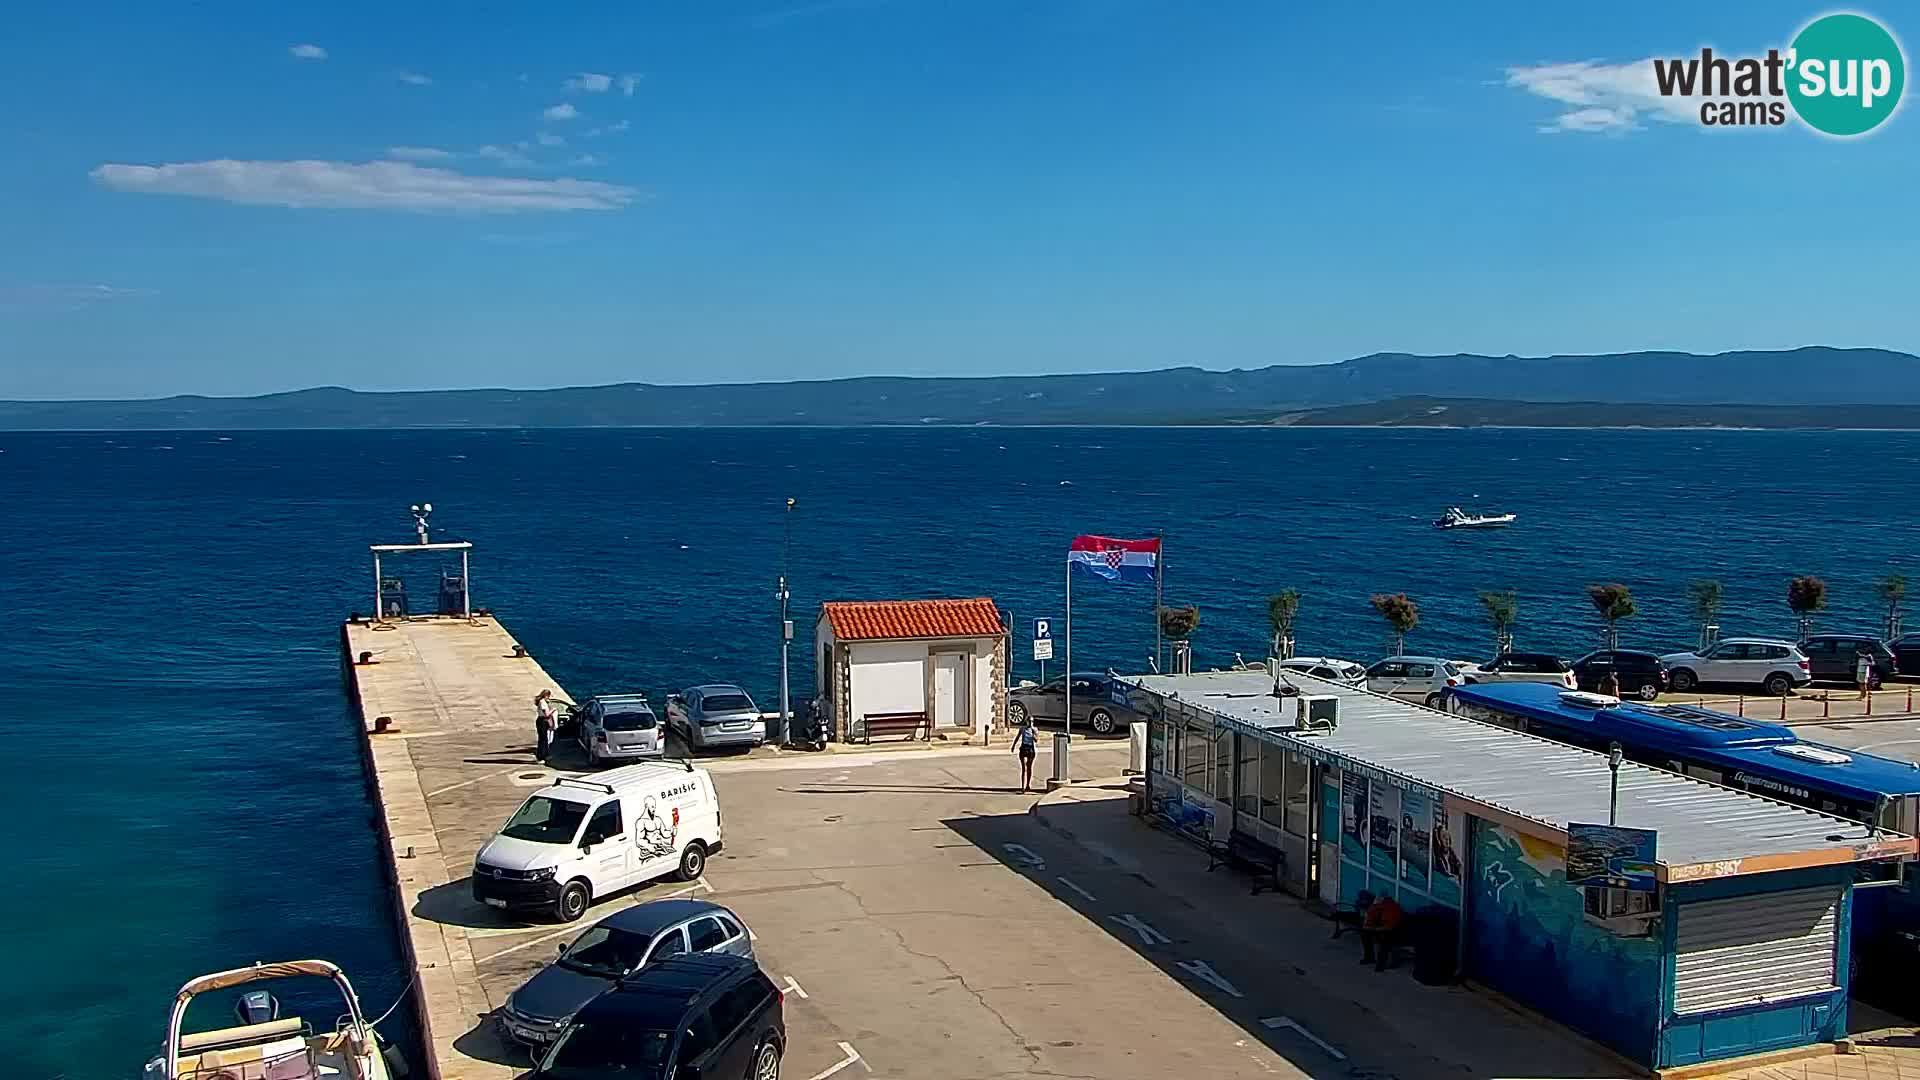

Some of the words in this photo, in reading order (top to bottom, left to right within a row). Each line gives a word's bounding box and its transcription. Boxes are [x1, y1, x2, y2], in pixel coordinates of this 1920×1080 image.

[1037, 621, 1049, 638] P
[1352, 762, 1383, 782] STATION
[1386, 773, 1410, 790] TICKET
[1411, 782, 1439, 800] OFFICE
